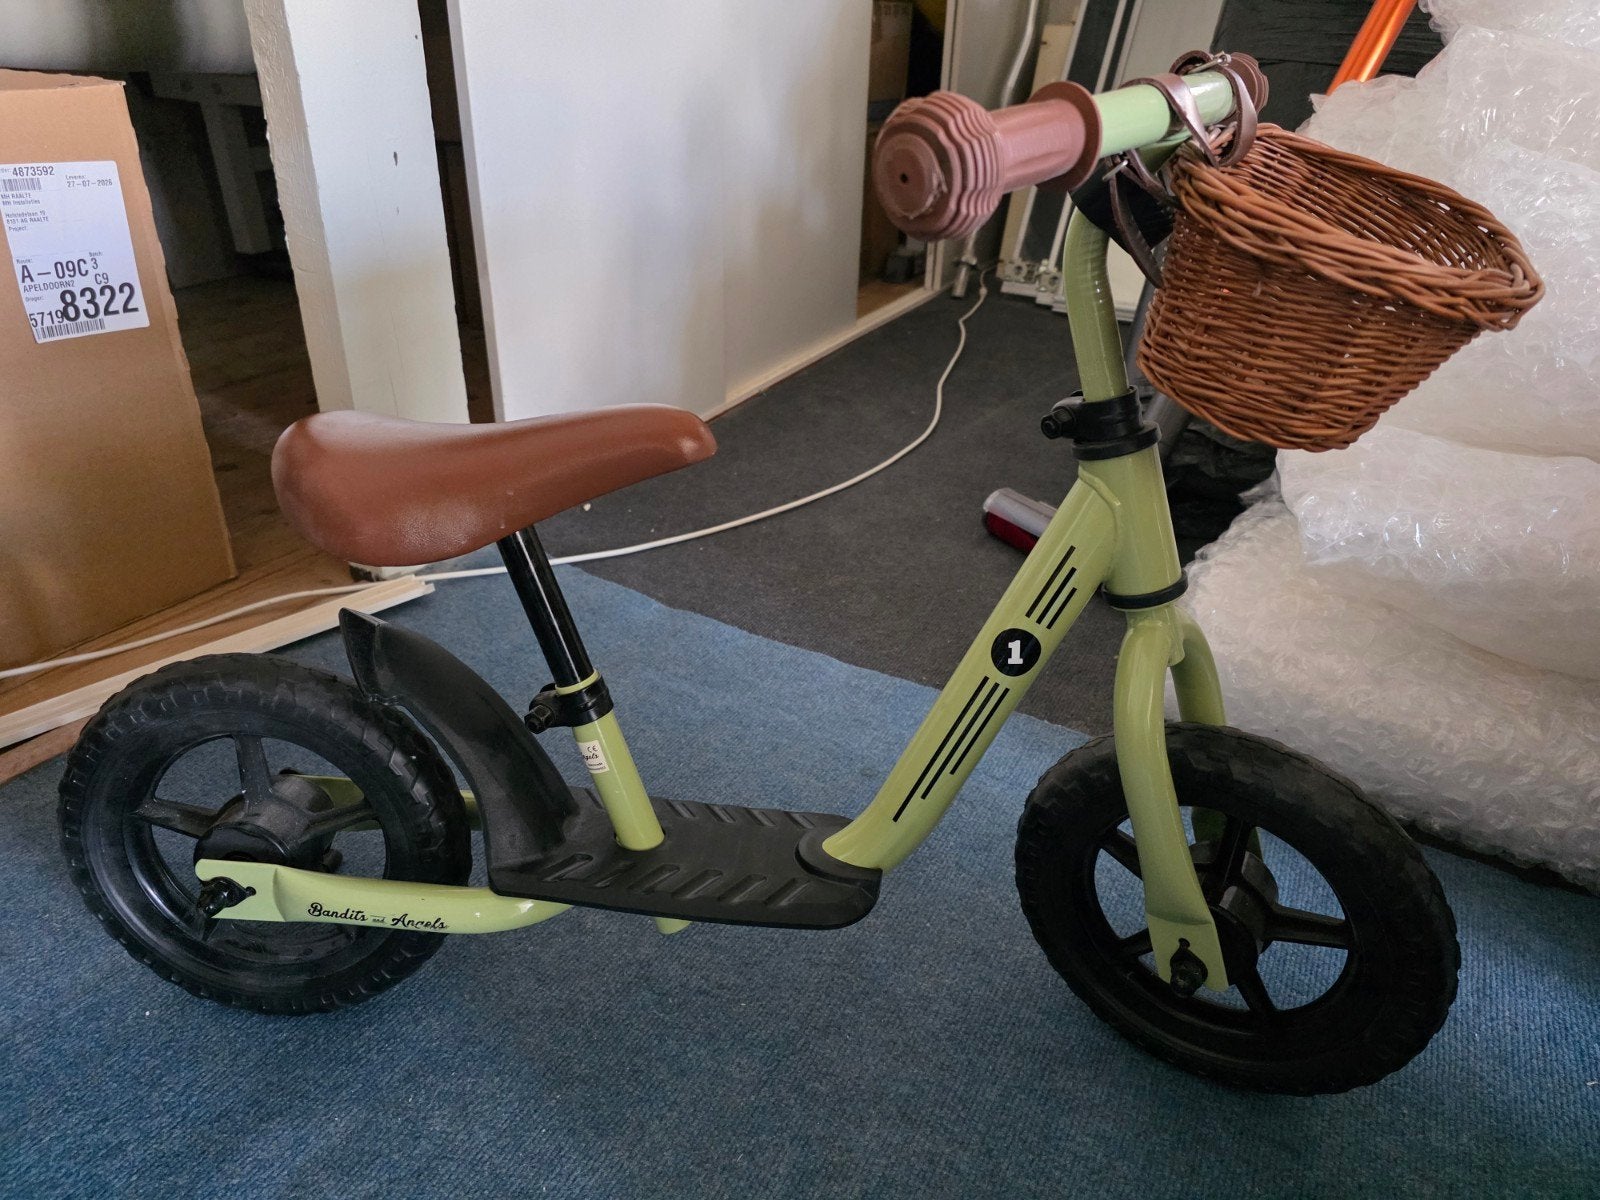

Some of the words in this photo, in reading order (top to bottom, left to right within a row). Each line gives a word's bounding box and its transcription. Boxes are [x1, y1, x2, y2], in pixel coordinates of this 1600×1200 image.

[12, 166, 55, 177] 4873592
[90, 257, 99, 270] 3
[94, 272, 110, 285] C9
[23, 280, 76, 293] APELDOORN2
[60, 282, 139, 322] 8322
[1007, 639, 1024, 665] 1
[307, 902, 369, 922] Bandits
